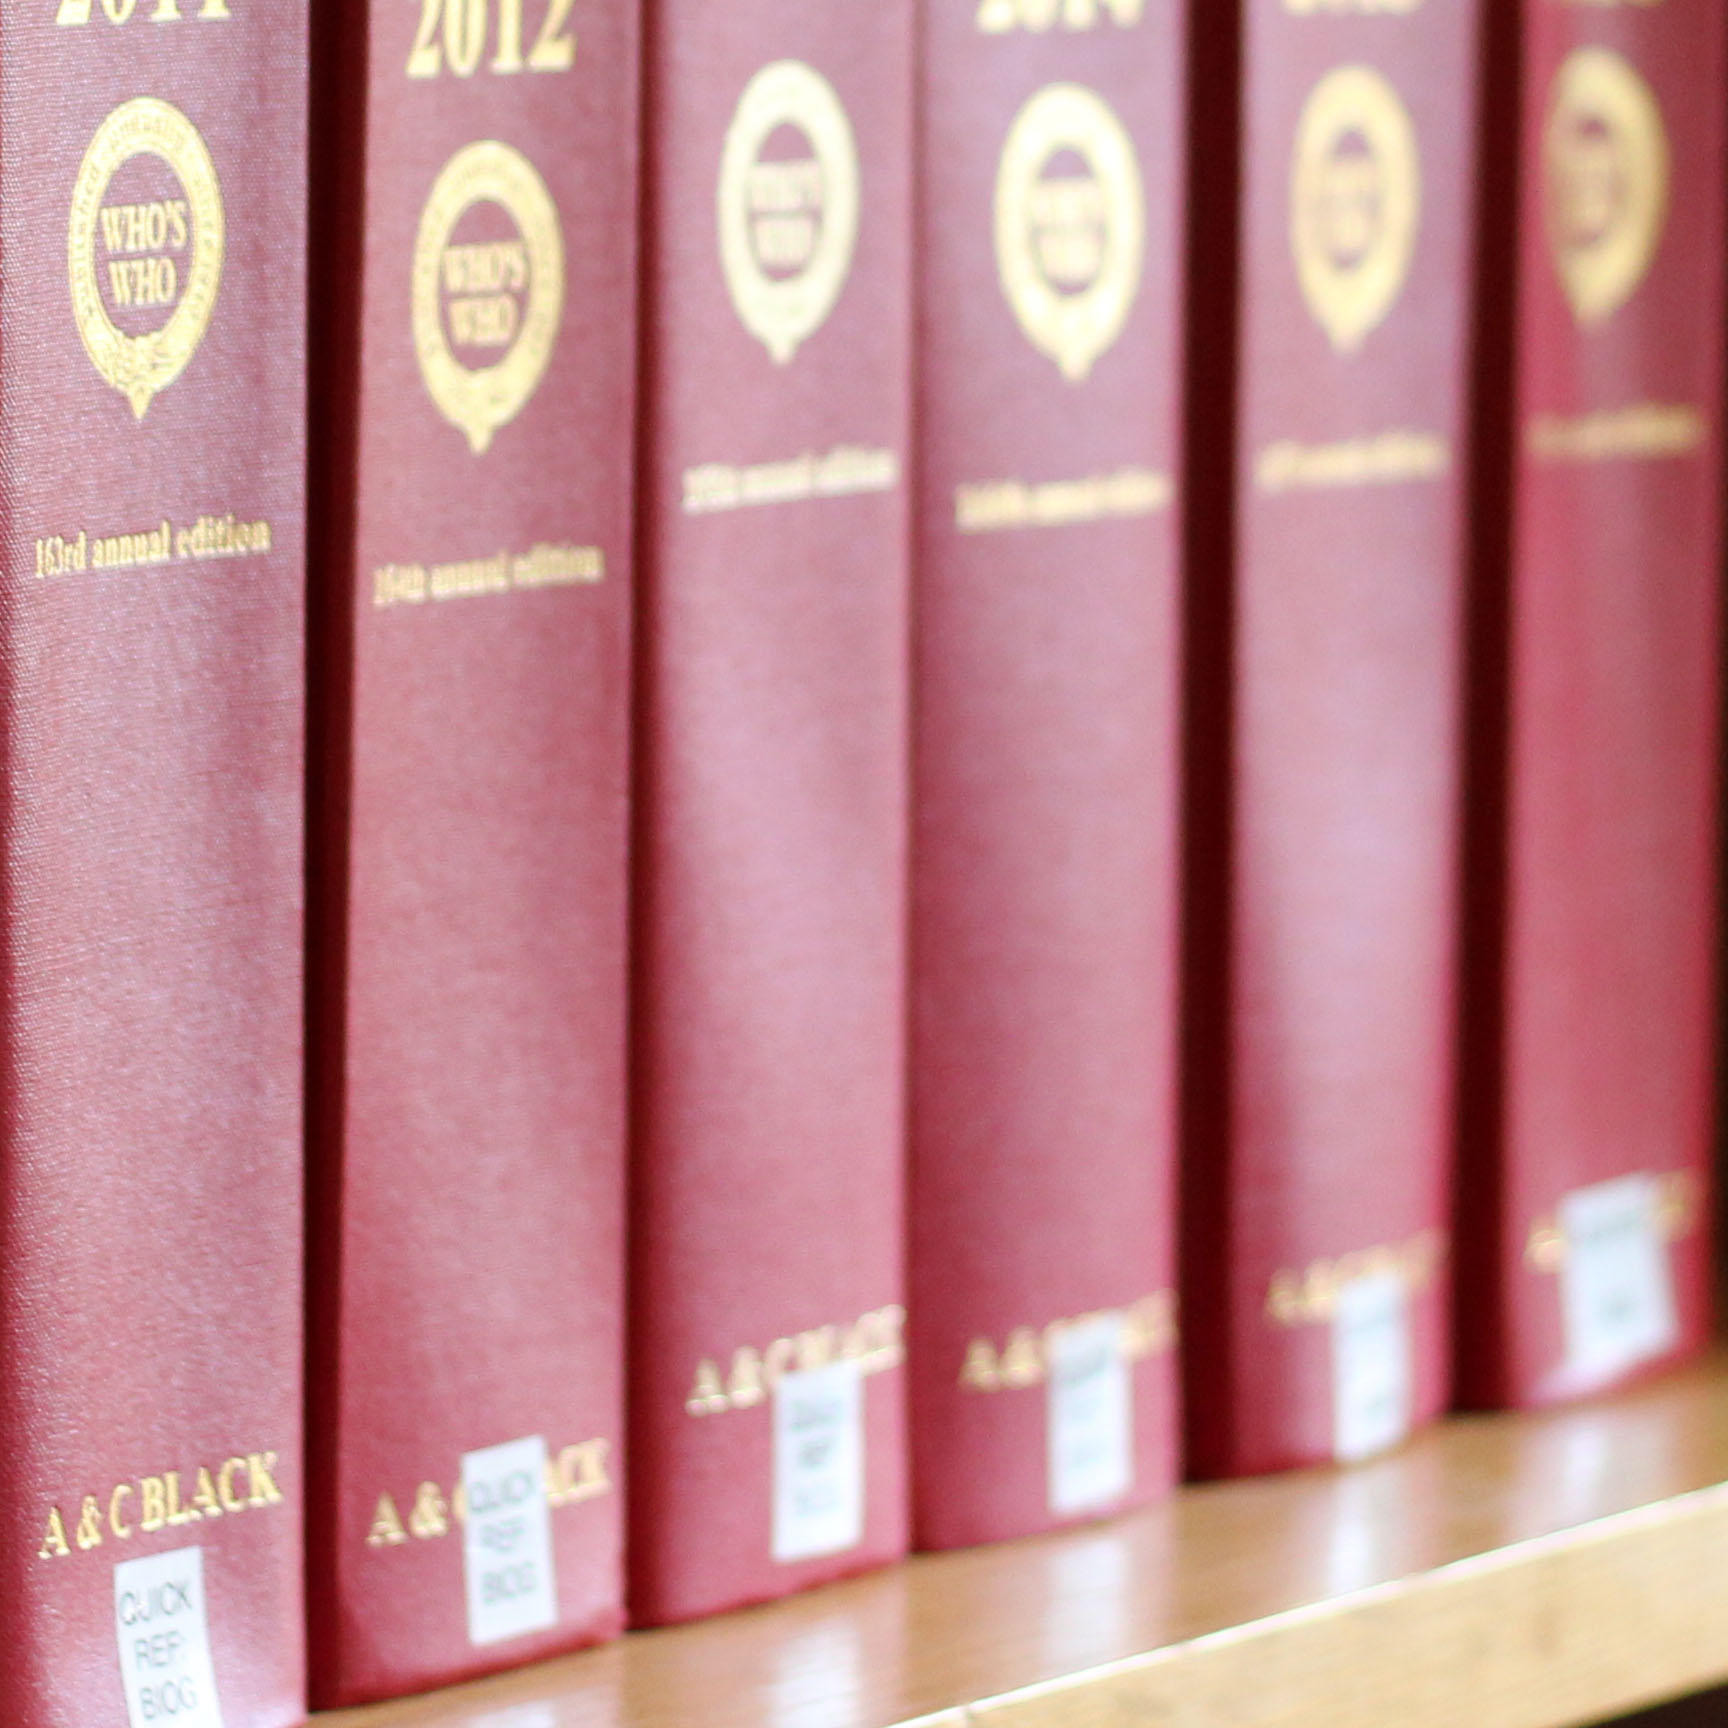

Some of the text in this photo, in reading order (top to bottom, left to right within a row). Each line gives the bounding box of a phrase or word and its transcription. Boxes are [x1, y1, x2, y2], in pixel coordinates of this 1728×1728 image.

[100, 200, 188, 254] WHO'S
[109, 257, 178, 306] WHO
[36, 513, 271, 579] 163rd annual edition
[37, 1451, 283, 1559] A & C BLACK
[366, 1490, 407, 1547] A
